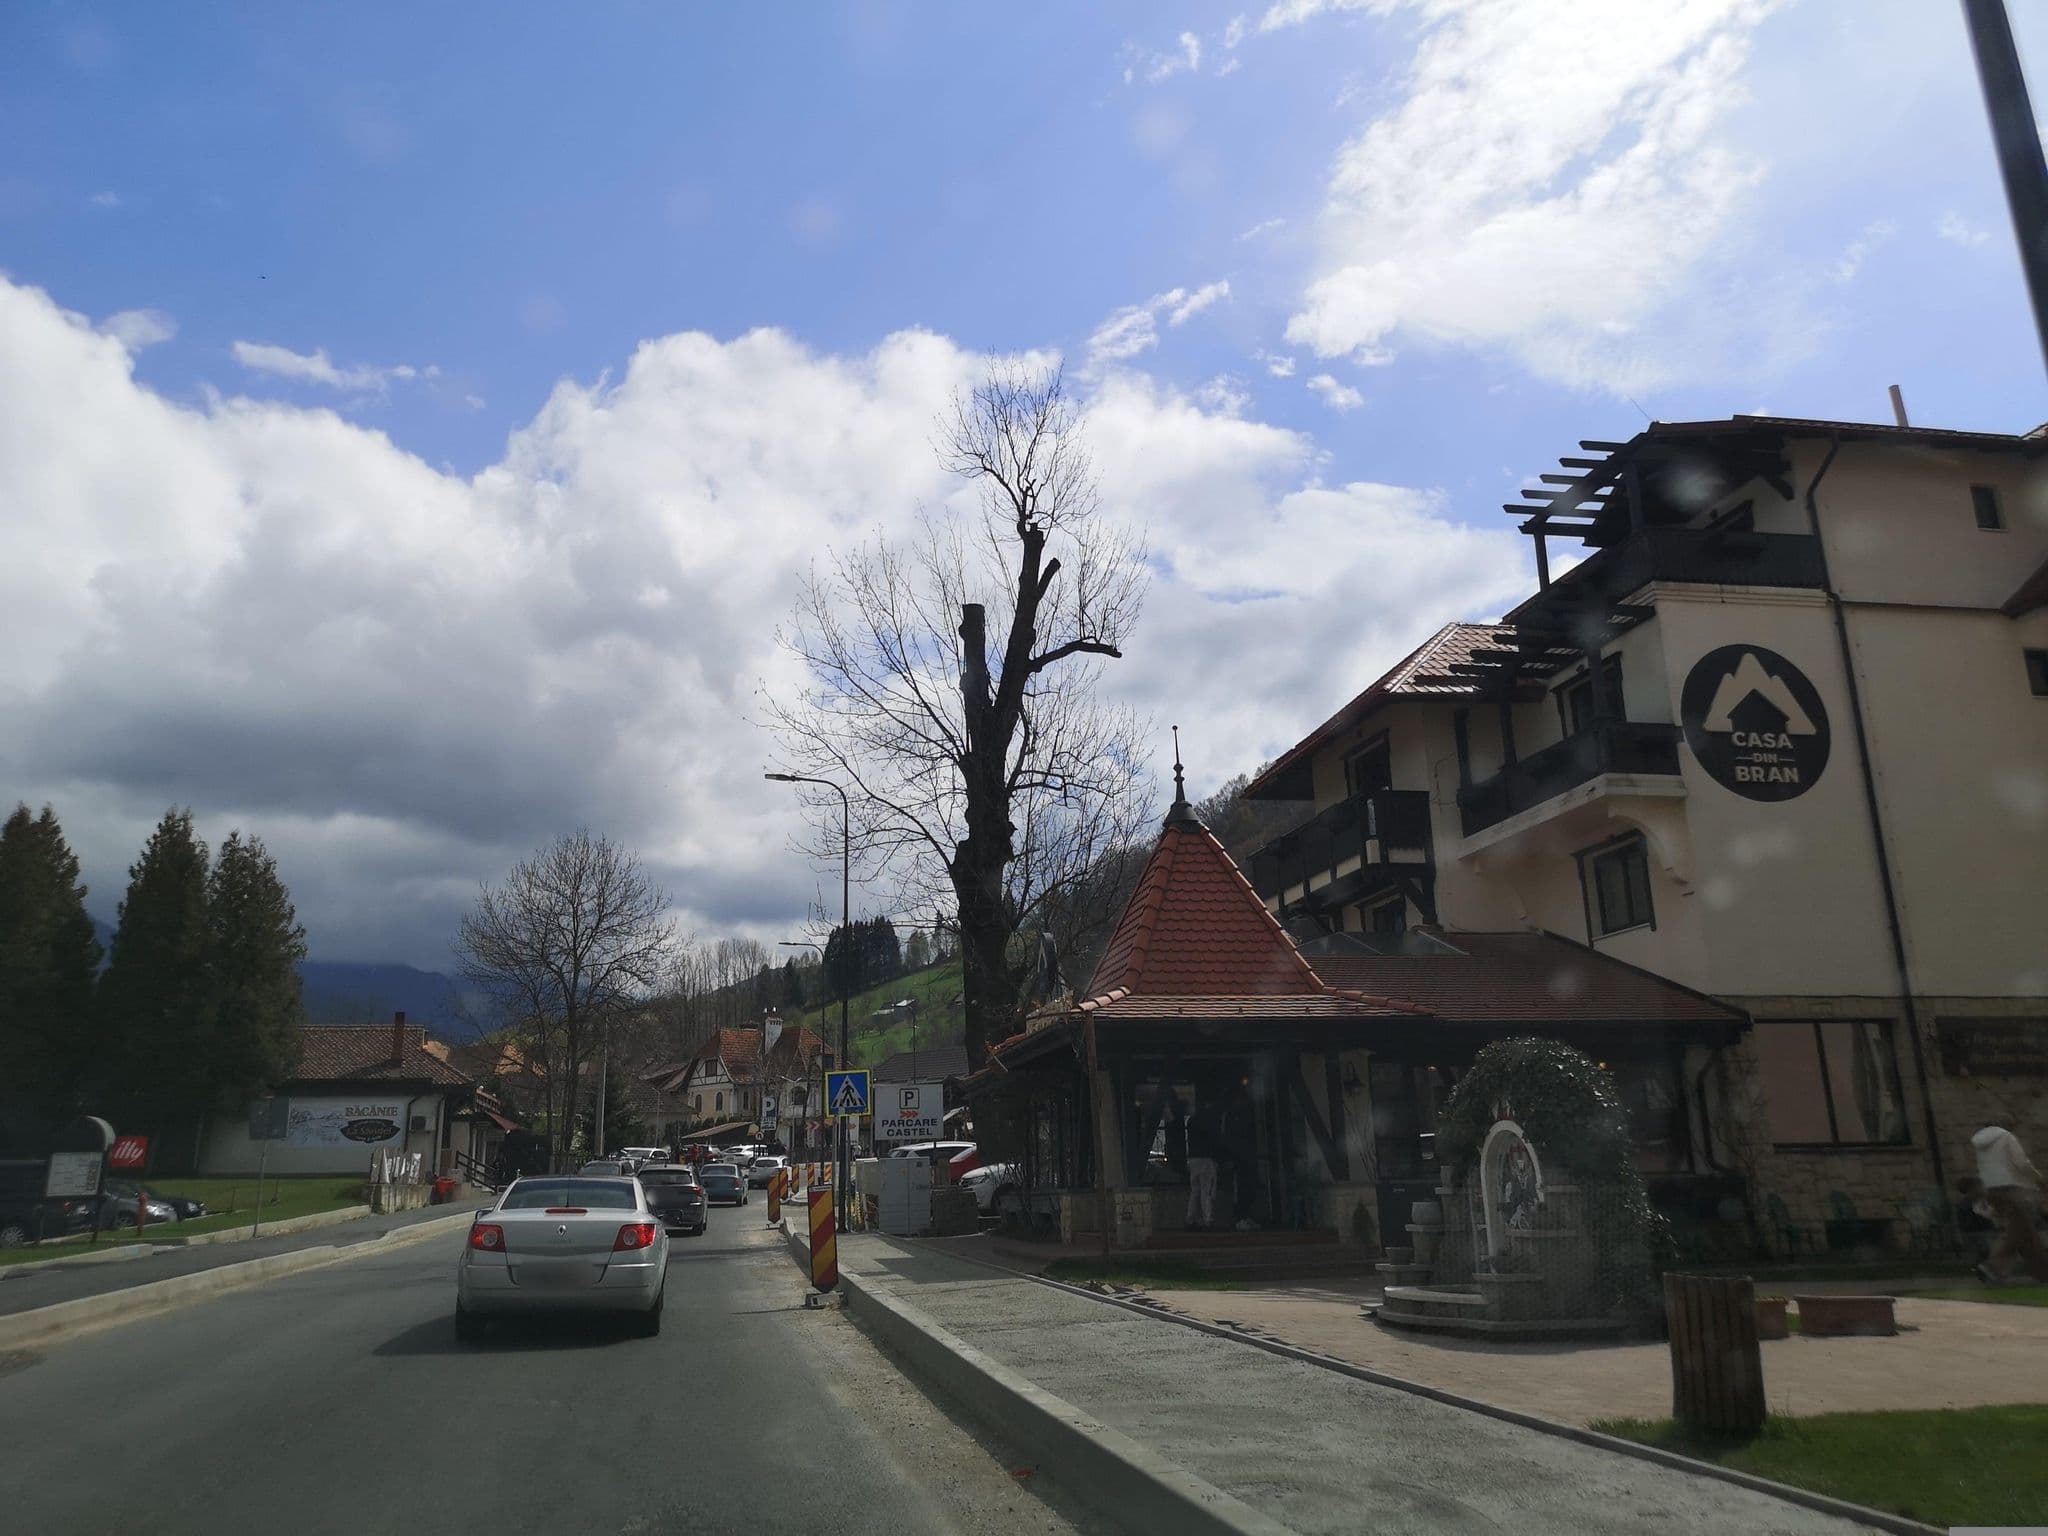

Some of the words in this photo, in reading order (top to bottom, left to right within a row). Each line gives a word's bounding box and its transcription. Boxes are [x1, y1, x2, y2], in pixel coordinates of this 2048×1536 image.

[1731, 731, 1794, 749] CASA
[1752, 752, 1778, 764] DIN
[1735, 766, 1799, 783] BRAN
[881, 1118, 938, 1128] PARCARE
[886, 1127, 933, 1137] CASTEL
[113, 1140, 145, 1167] illy
